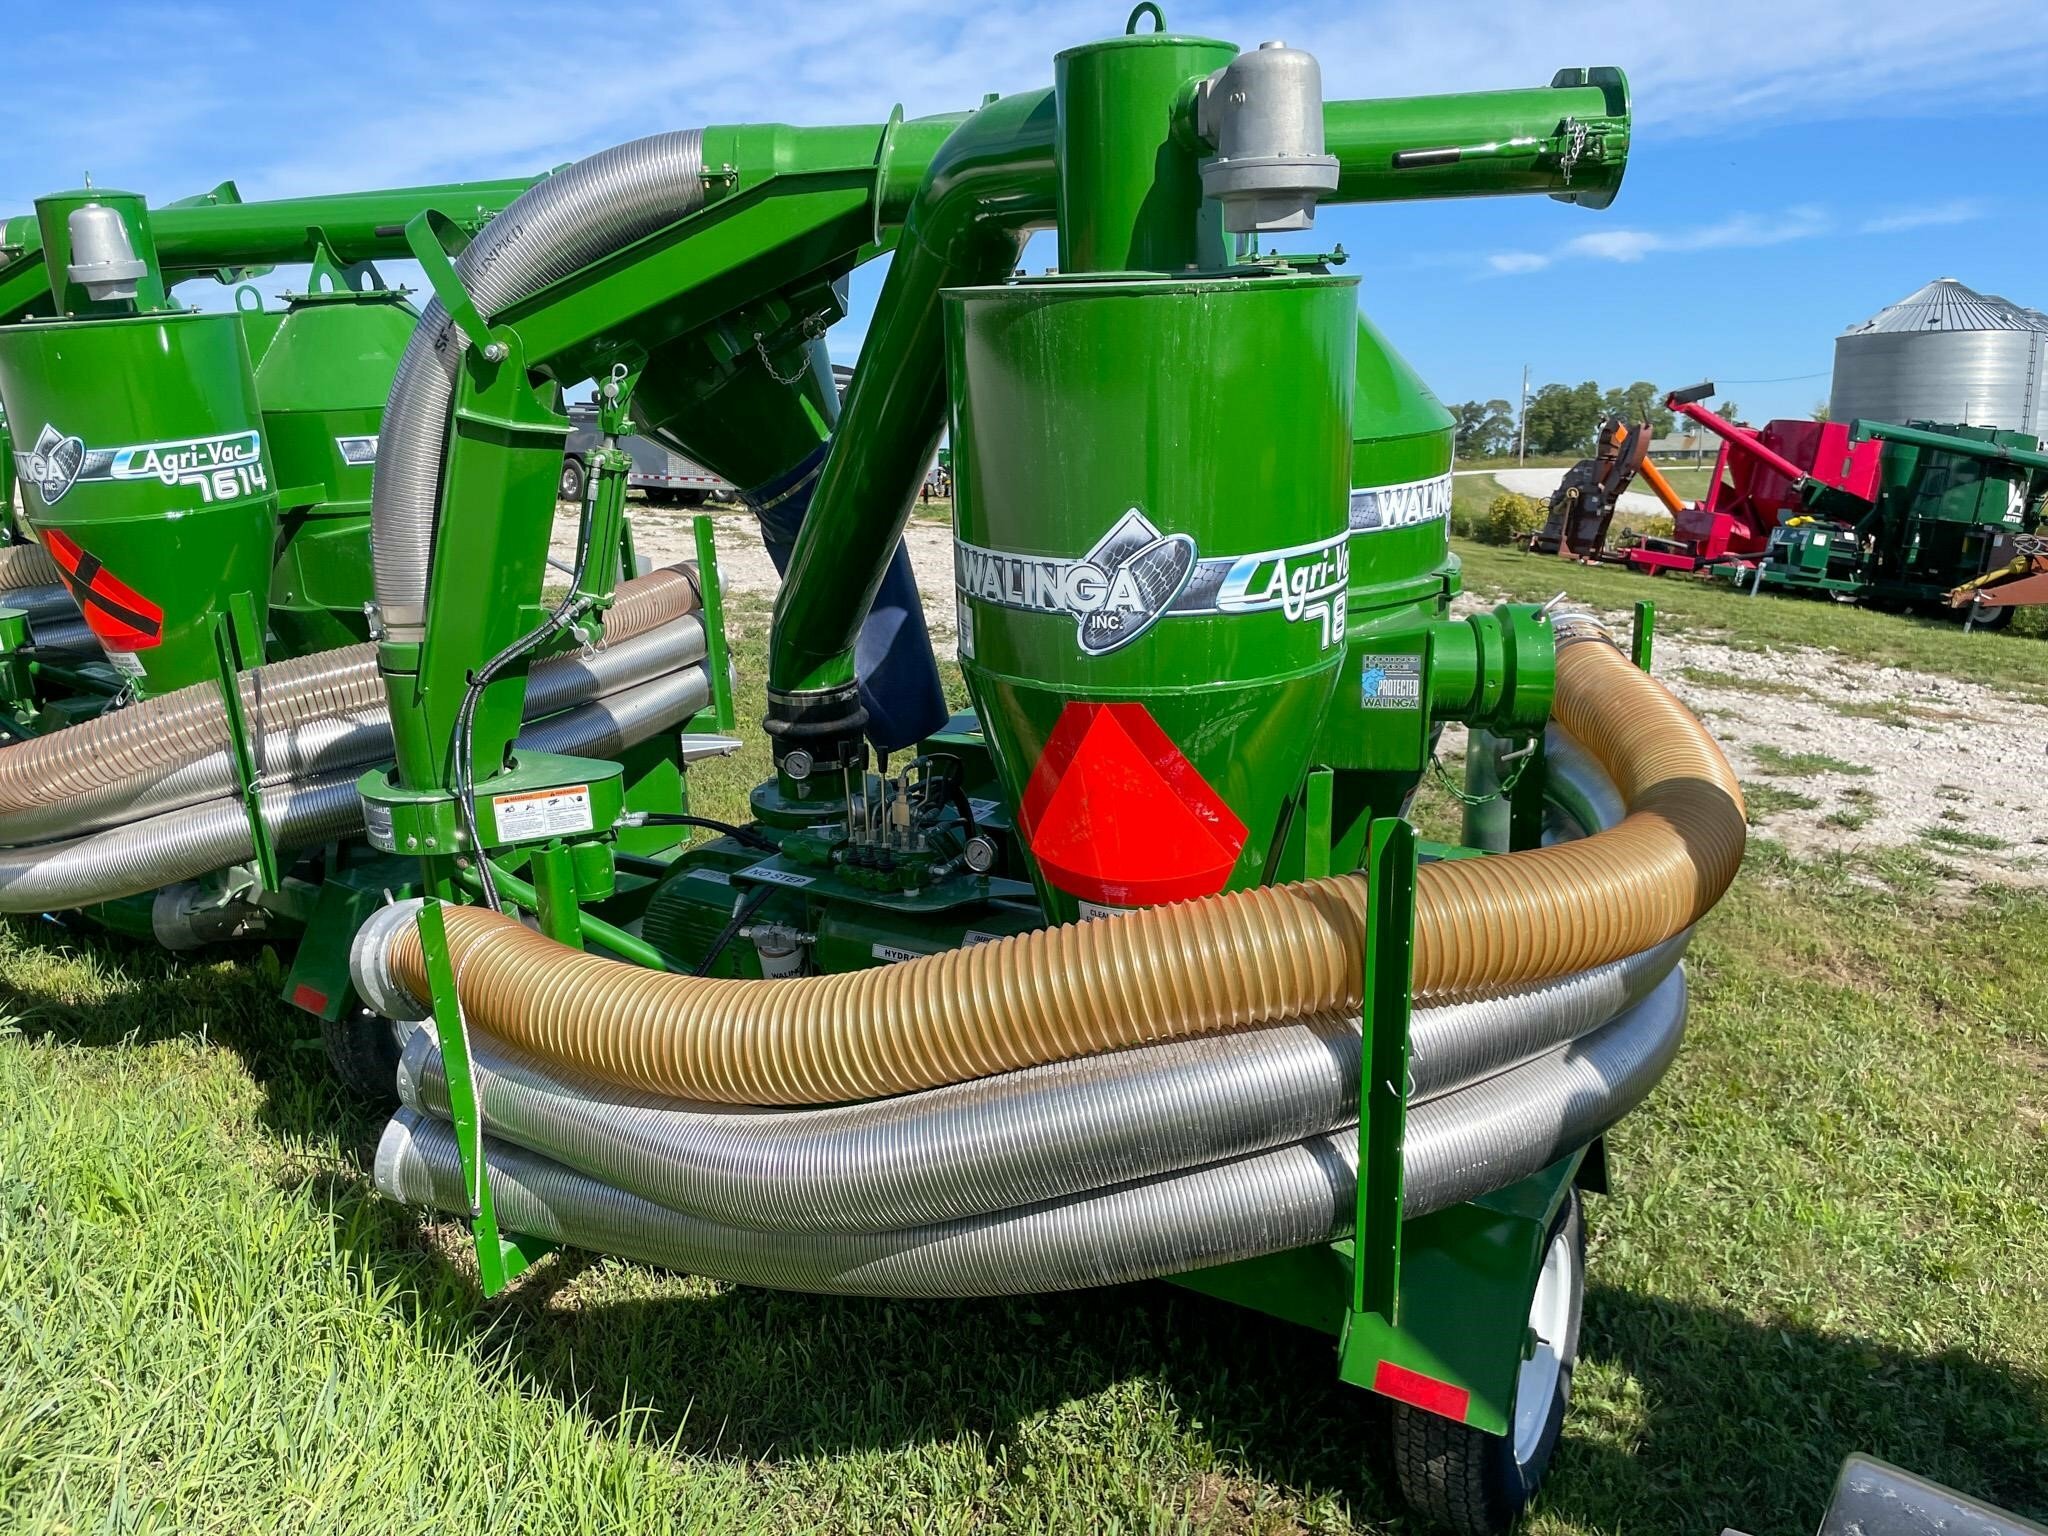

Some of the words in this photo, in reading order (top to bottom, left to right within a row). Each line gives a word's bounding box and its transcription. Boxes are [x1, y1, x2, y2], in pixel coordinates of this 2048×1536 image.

[143, 442, 243, 486] Agri-Vac
[179, 462, 268, 503] 7614
[961, 547, 1146, 614] WALINGA
[1092, 615, 1124, 630] INC.
[1378, 679, 1419, 697] PROTECTED
[1364, 698, 1417, 708] WALINGA
[750, 868, 770, 877] NO
[771, 873, 806, 884] STEP
[884, 948, 922, 961] HYDRA
